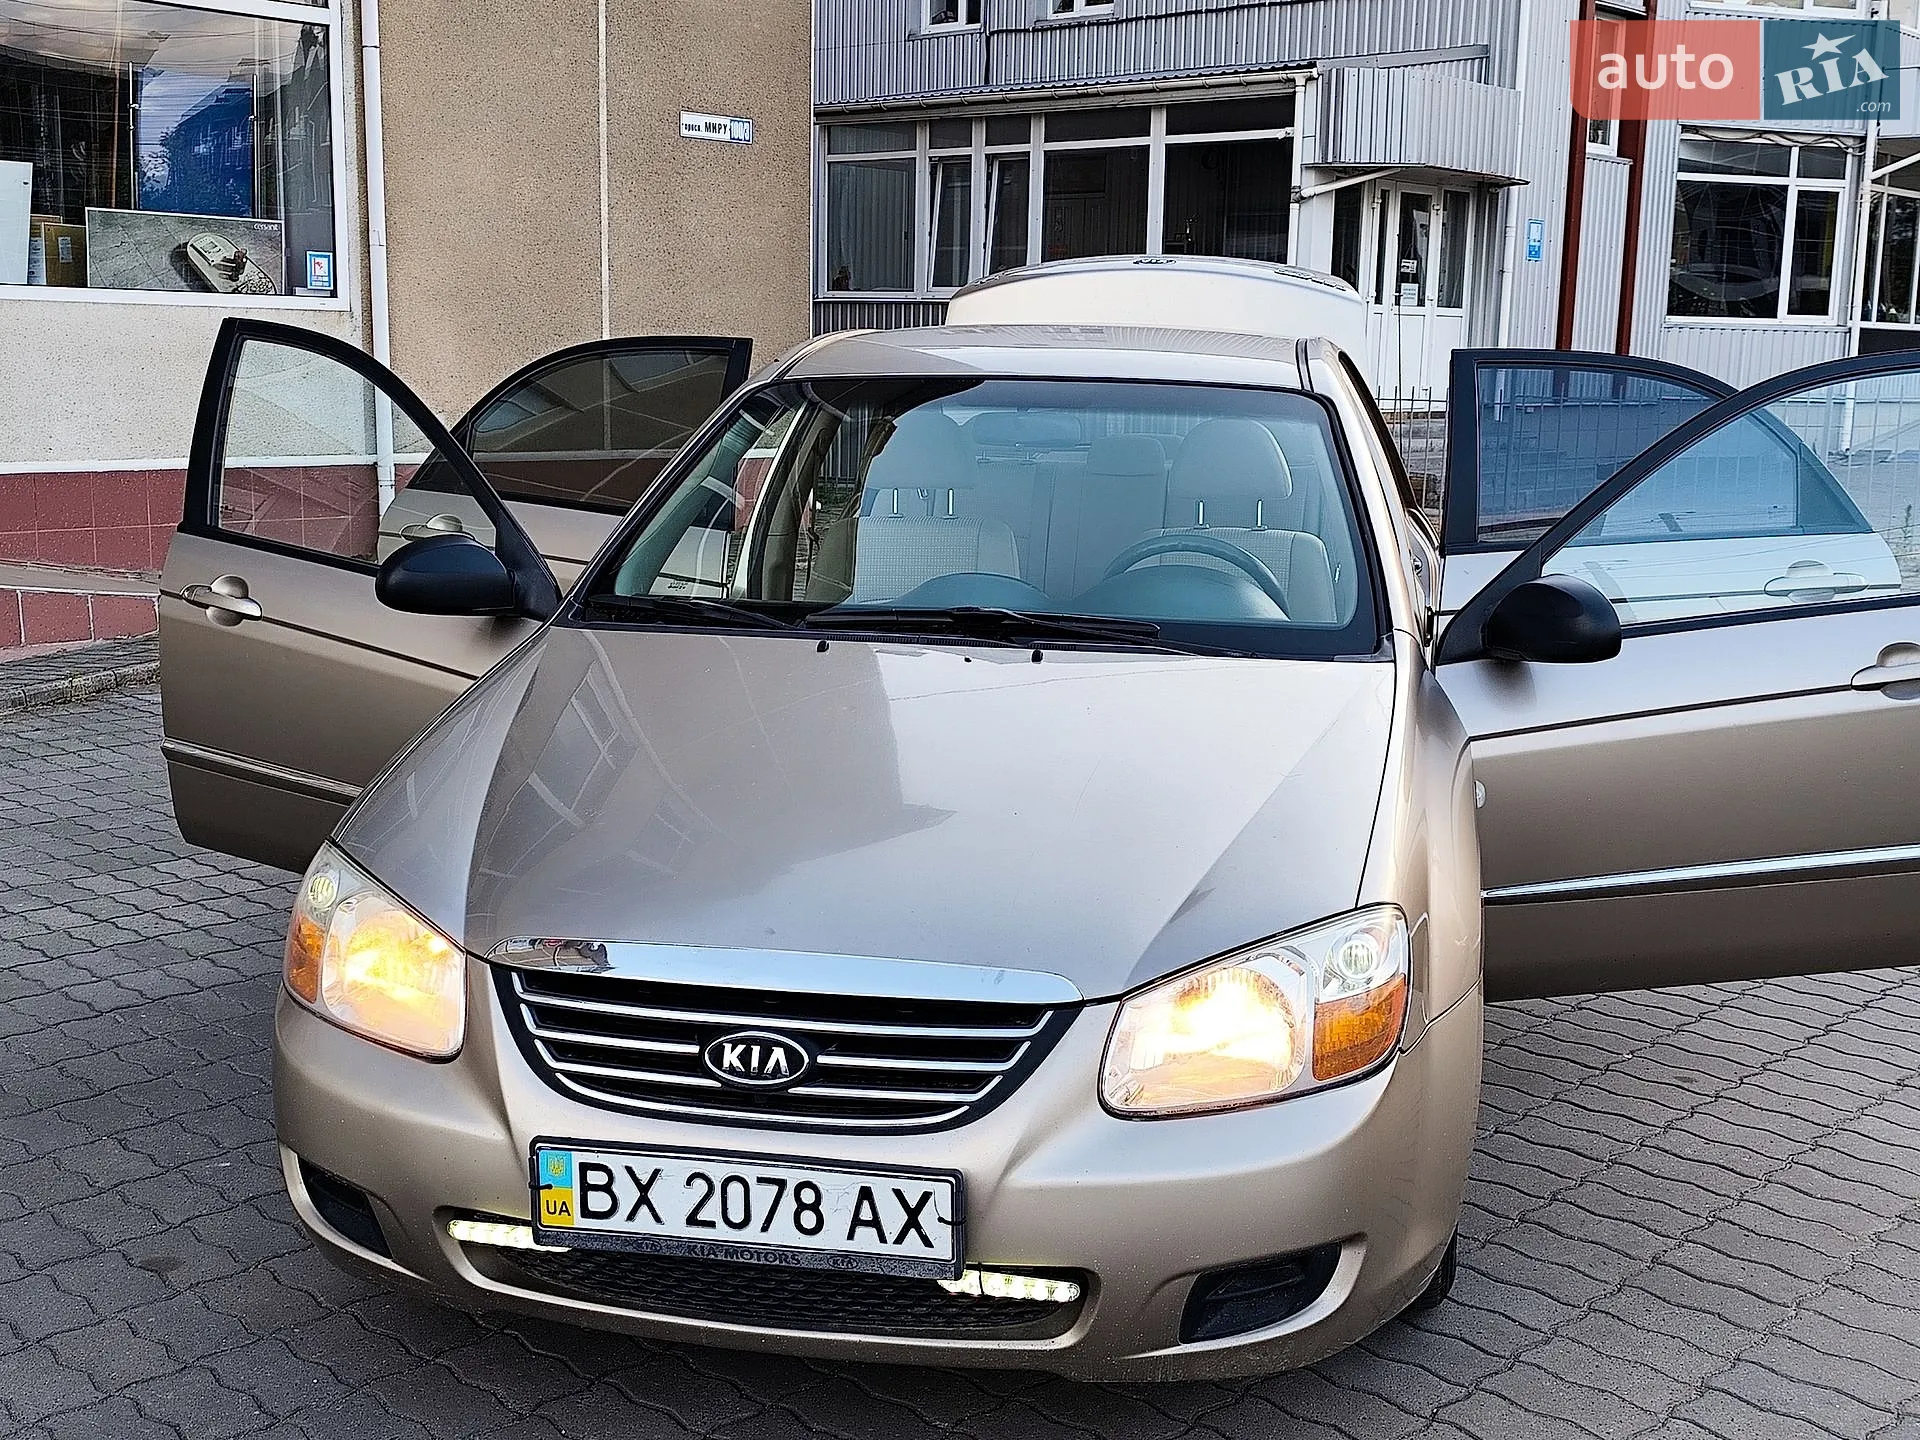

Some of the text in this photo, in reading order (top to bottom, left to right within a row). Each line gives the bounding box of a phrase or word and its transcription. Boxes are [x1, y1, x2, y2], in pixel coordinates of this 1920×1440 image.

[722, 1043, 790, 1078] KIA
[545, 1199, 571, 1217] UA
[578, 1161, 935, 1249] BX 2078 AX
[724, 1248, 801, 1266] MOTORS
